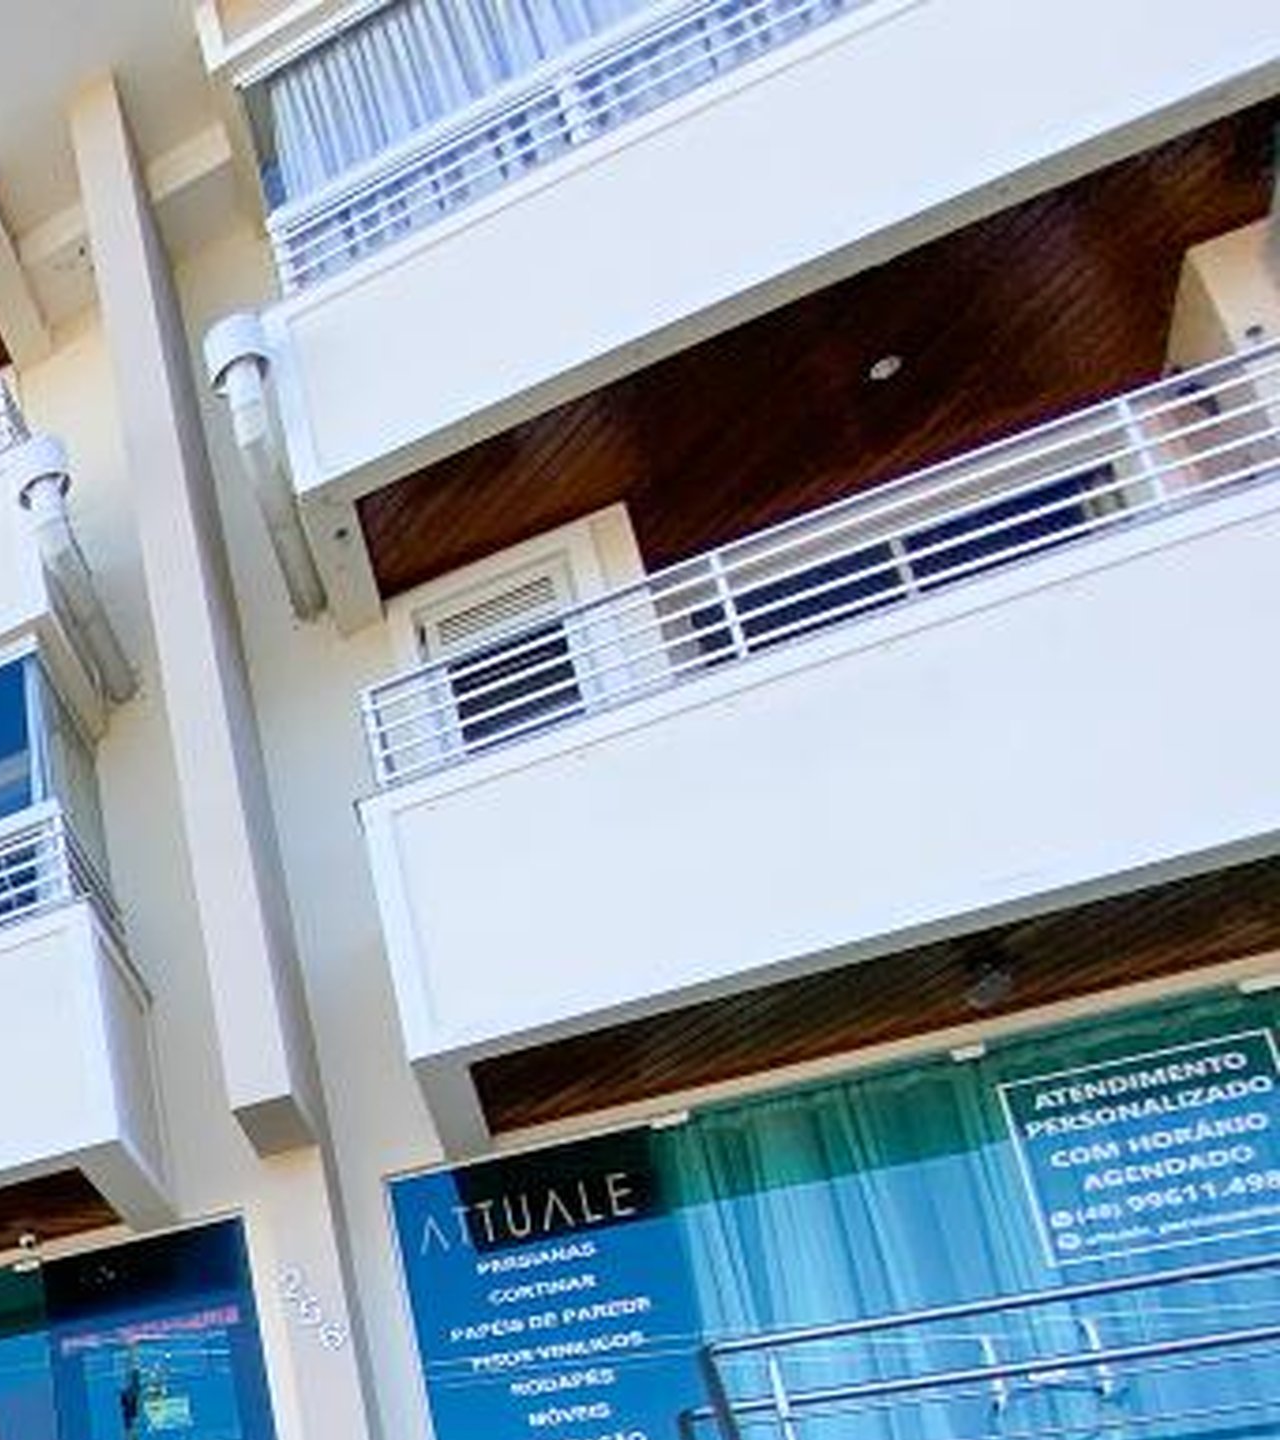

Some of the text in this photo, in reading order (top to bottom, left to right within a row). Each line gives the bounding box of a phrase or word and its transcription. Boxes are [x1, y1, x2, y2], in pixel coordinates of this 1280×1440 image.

[1024, 1075, 1273, 1139] PERSONALIZADO
[1034, 1051, 1248, 1111] ATENDIMENTO
[1050, 1112, 1269, 1169] COM HORÁRIO
[1083, 1145, 1255, 1191] AGENDADO
[418, 1172, 637, 1255] ATTUALE
[476, 1240, 597, 1275] PERSIANAS
[528, 1311, 559, 1330] DE
